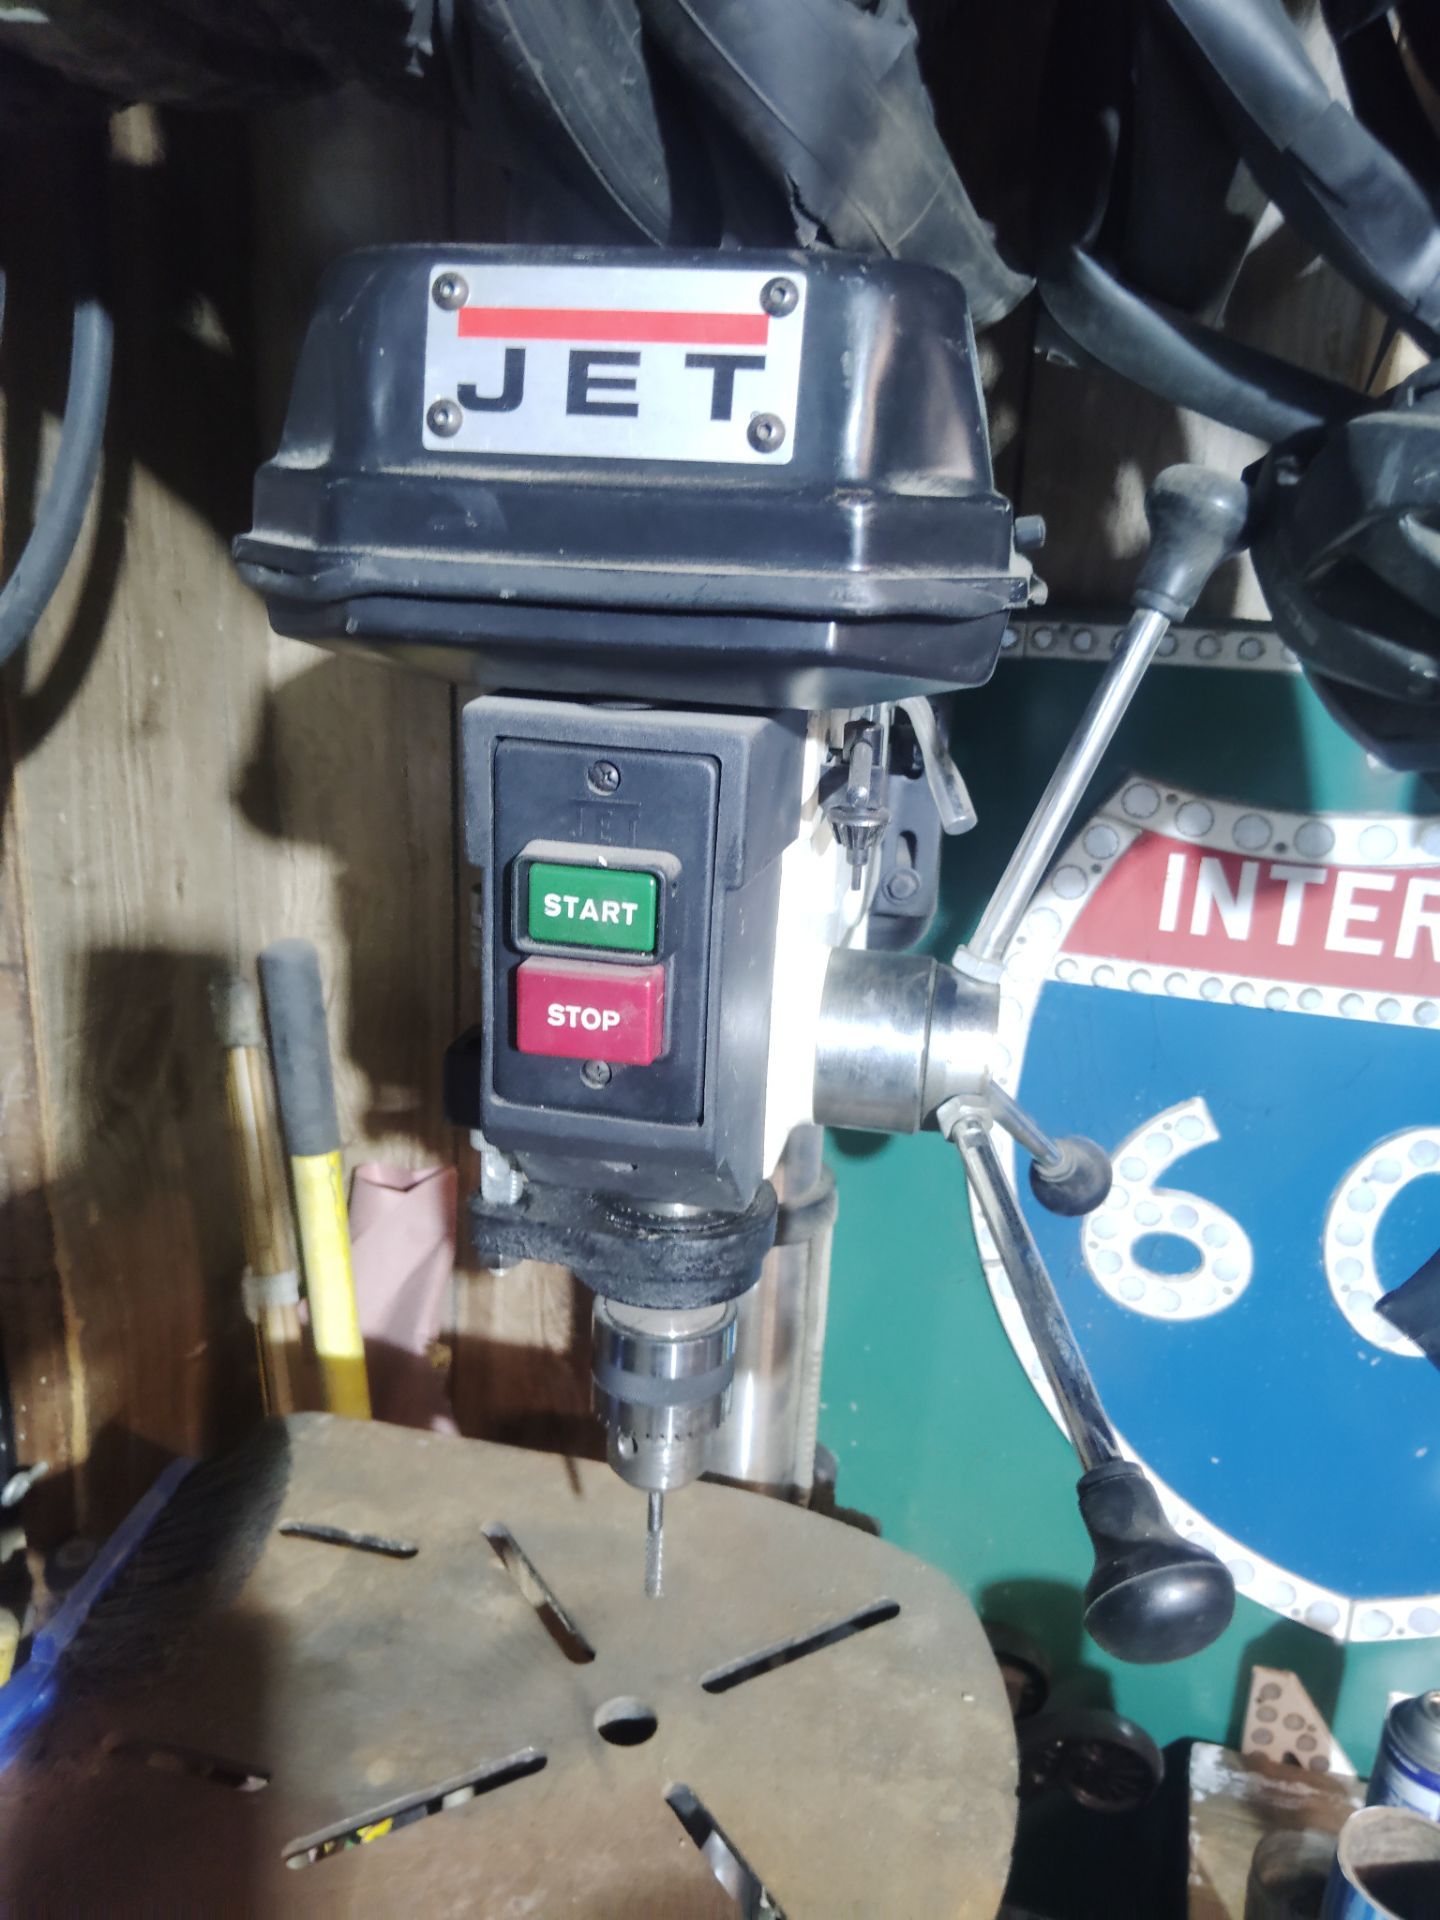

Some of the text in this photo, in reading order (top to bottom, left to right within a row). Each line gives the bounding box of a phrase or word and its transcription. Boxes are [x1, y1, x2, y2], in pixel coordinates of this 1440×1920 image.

[456, 346, 767, 422] JET
[543, 893, 638, 926] START
[547, 1003, 621, 1031] STOP
